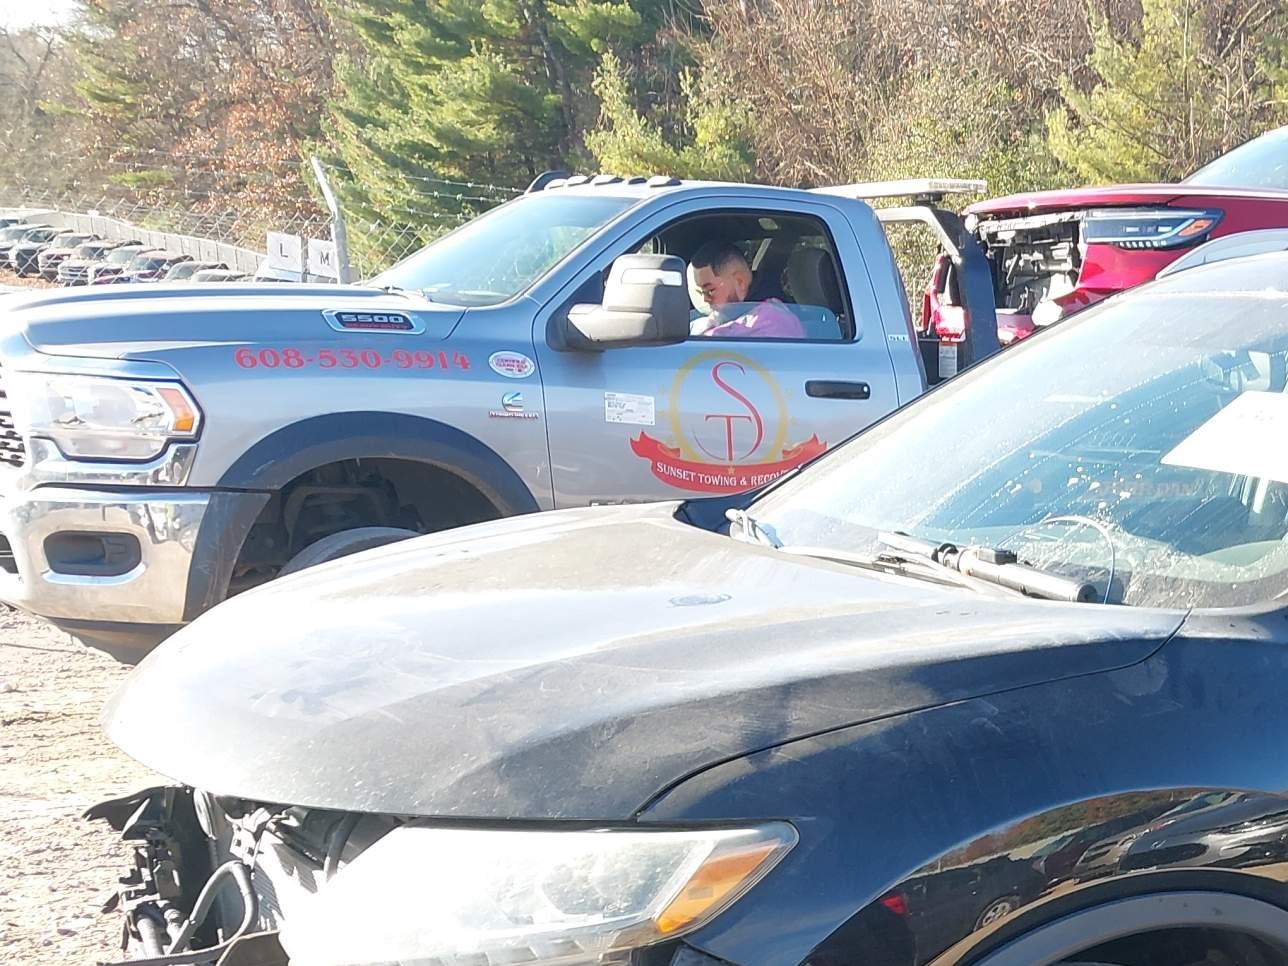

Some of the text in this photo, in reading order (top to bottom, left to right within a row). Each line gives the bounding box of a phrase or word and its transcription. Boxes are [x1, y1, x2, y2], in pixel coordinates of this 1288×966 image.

[279, 242, 289, 258] L
[320, 250, 331, 266] M
[342, 314, 404, 323] 5500
[234, 347, 471, 371] 608-530-9914
[657, 463, 696, 481] SUNSET
[698, 473, 737, 487] TOWING
[739, 477, 748, 486] &
